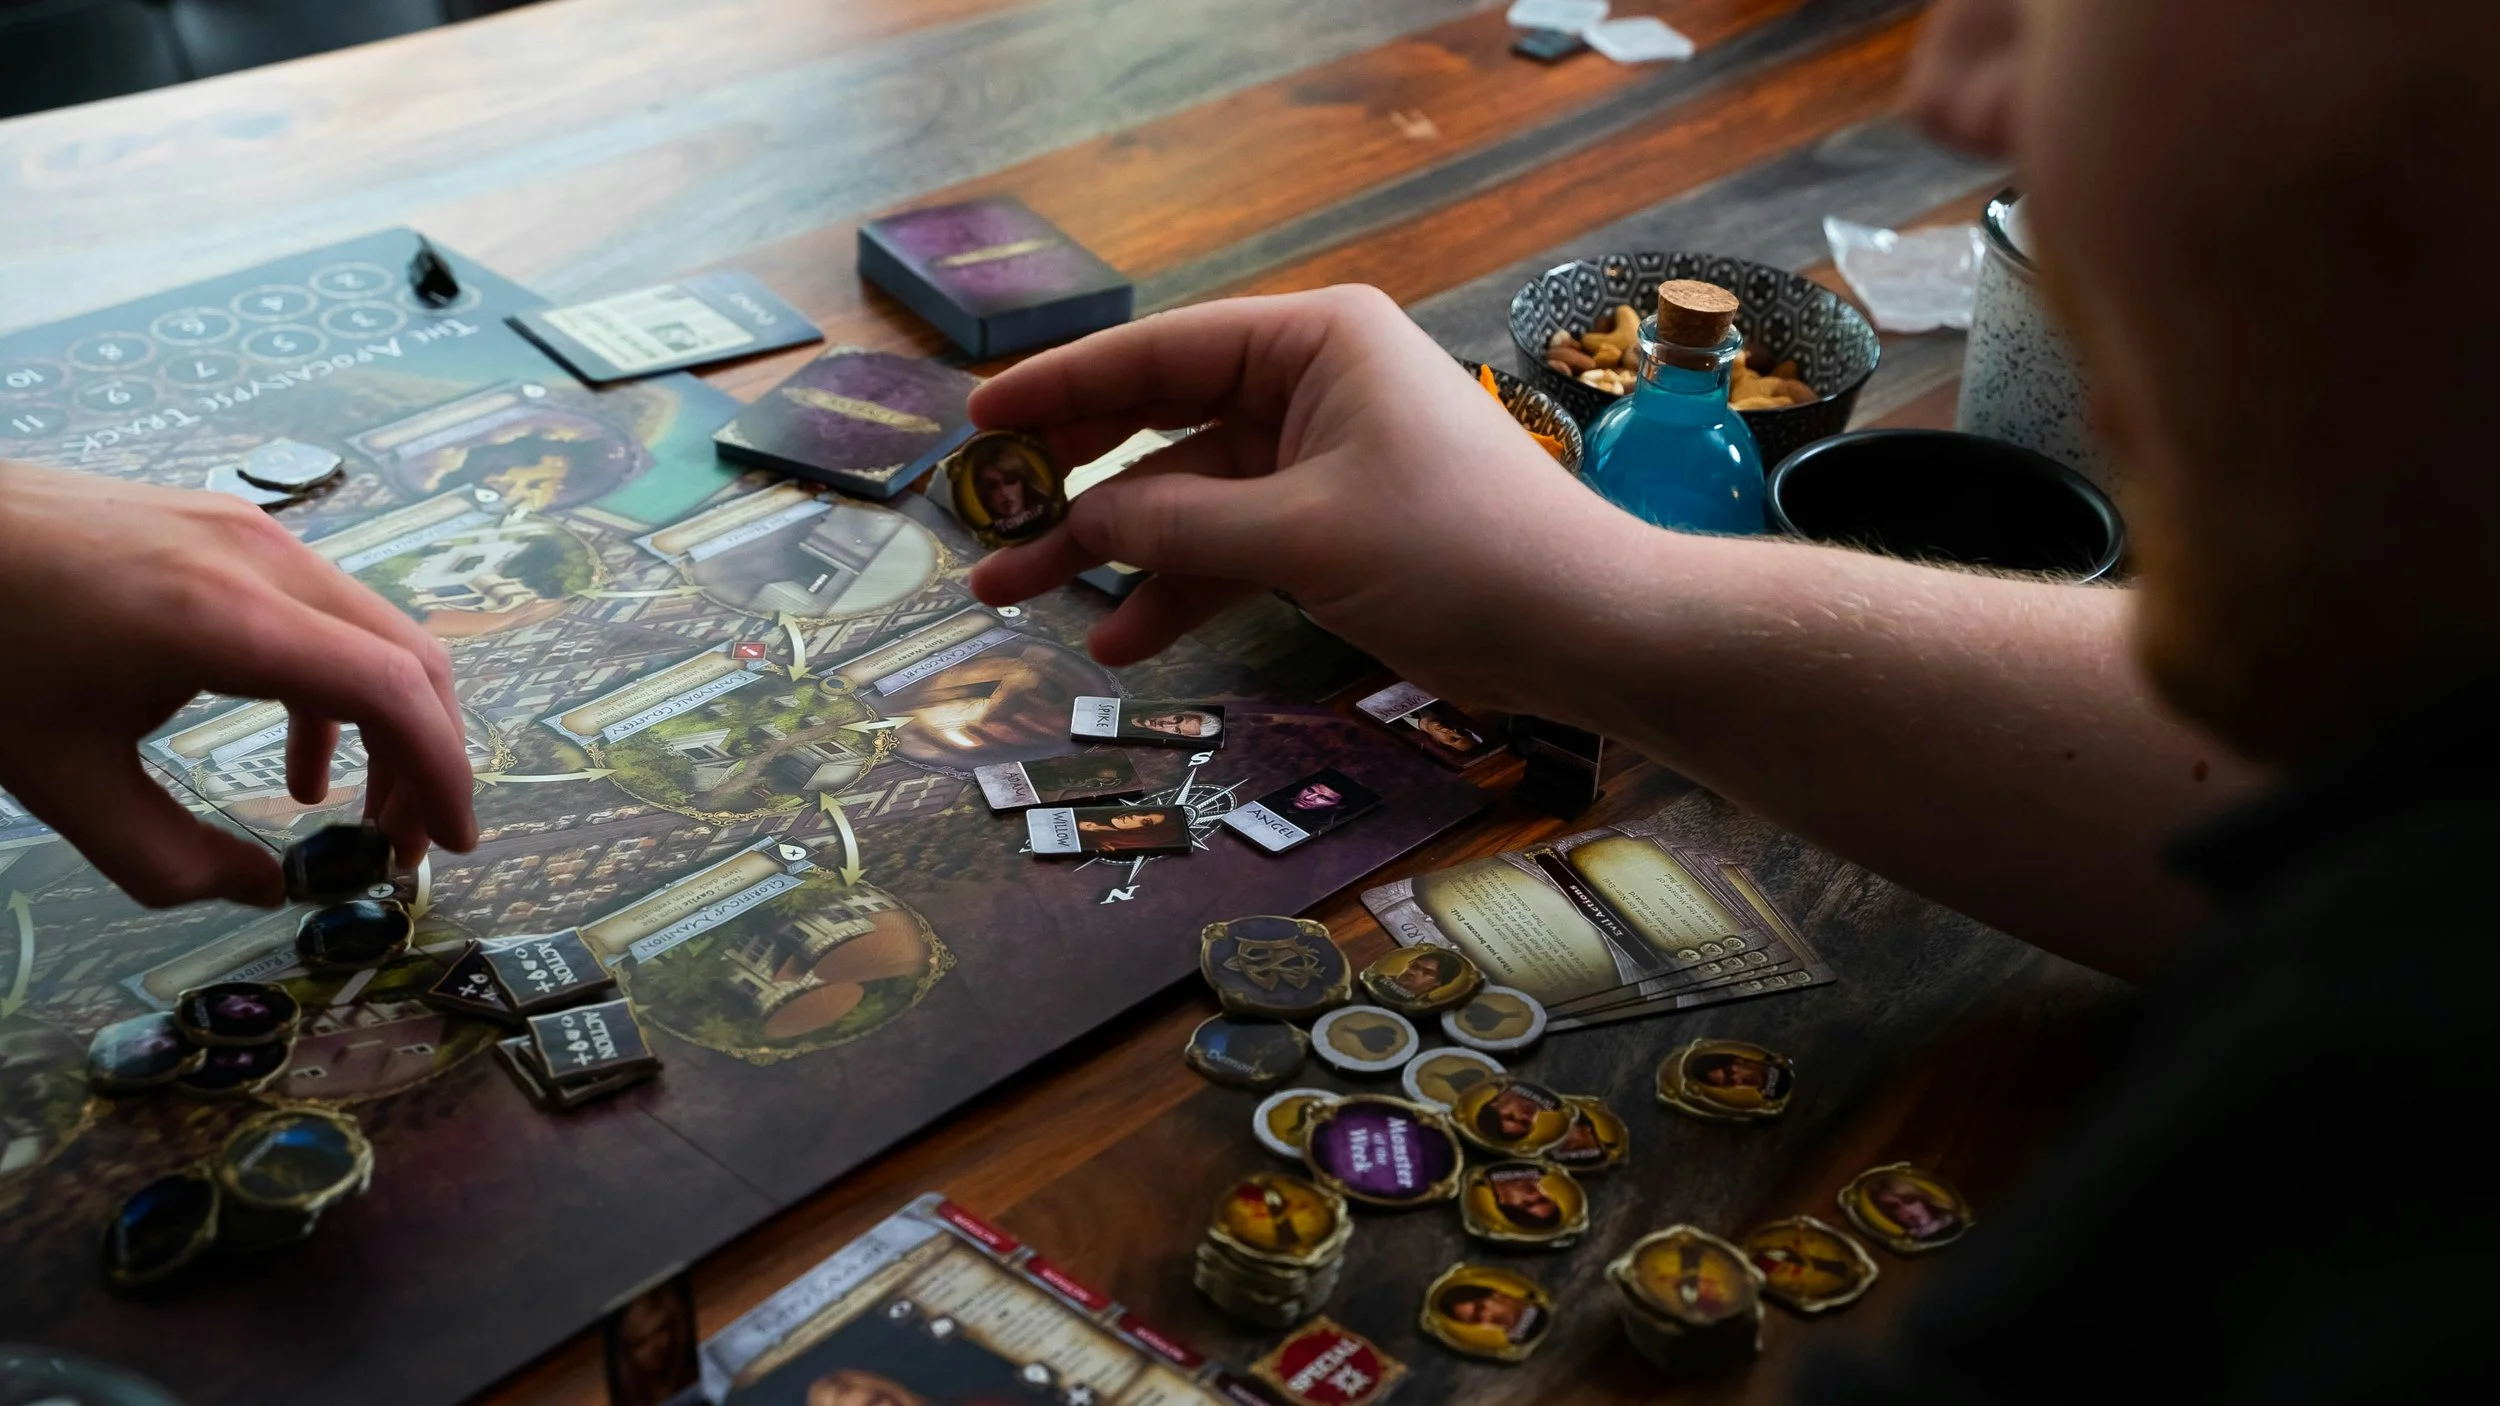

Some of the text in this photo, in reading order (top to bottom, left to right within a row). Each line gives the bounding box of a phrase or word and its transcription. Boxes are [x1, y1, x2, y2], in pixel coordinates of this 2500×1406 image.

[338, 273, 367, 290] 2
[259, 294, 286, 313] 4
[180, 314, 206, 335] 6
[351, 310, 378, 328] 3
[97, 341, 124, 361] 8
[273, 333, 297, 351] 5
[6, 369, 45, 388] 10
[195, 361, 218, 379] 7
[64, 318, 478, 457] THE APOCALYPSE TRACK
[106, 387, 132, 405] 9
[12, 414, 46, 433] 11
[993, 504, 1047, 535] Townie
[923, 638, 945, 649] Holy
[897, 648, 925, 661] Water
[902, 639, 988, 679] THE CATACOMBS
[700, 663, 713, 671] are
[651, 669, 699, 693] unprotected
[612, 673, 747, 734] SUNNYDALE CEMETERY
[616, 691, 651, 707] Townies
[215, 712, 256, 731] Location
[1096, 703, 1113, 727] SPIKE
[1188, 751, 1214, 768] S
[1004, 771, 1026, 800] ADAM
[1051, 810, 1071, 847] WILLOW
[1247, 808, 1295, 840] ANGEL
[719, 866, 742, 879] Item
[722, 875, 745, 887] Take
[671, 889, 695, 902] then
[681, 889, 715, 906] Garlic
[1099, 884, 1141, 905] N
[1601, 877, 1629, 901] Non-Evil
[1662, 883, 1688, 905] Monster
[1675, 883, 1688, 893] Big
[1685, 893, 1697, 902] the
[658, 904, 682, 918] from
[1569, 884, 1624, 936] Evil Actions
[1625, 900, 1637, 909] for
[1685, 905, 1698, 914] the
[640, 879, 785, 951] GLORIFICUS' MANSION
[642, 916, 658, 926] the
[1634, 909, 1653, 924] Items
[1695, 914, 1719, 935] Activate
[1702, 909, 1718, 924] Week
[1679, 918, 1703, 939] Activate
[1717, 924, 1729, 933] the
[1450, 907, 1514, 974] When you become Evil:
[536, 942, 578, 987] ACTION
[583, 1011, 618, 1059] ACTION
[1349, 1128, 1372, 1172] Week
[1387, 1117, 1413, 1187] Monster
[1285, 1336, 1363, 1394] SPECIAL
